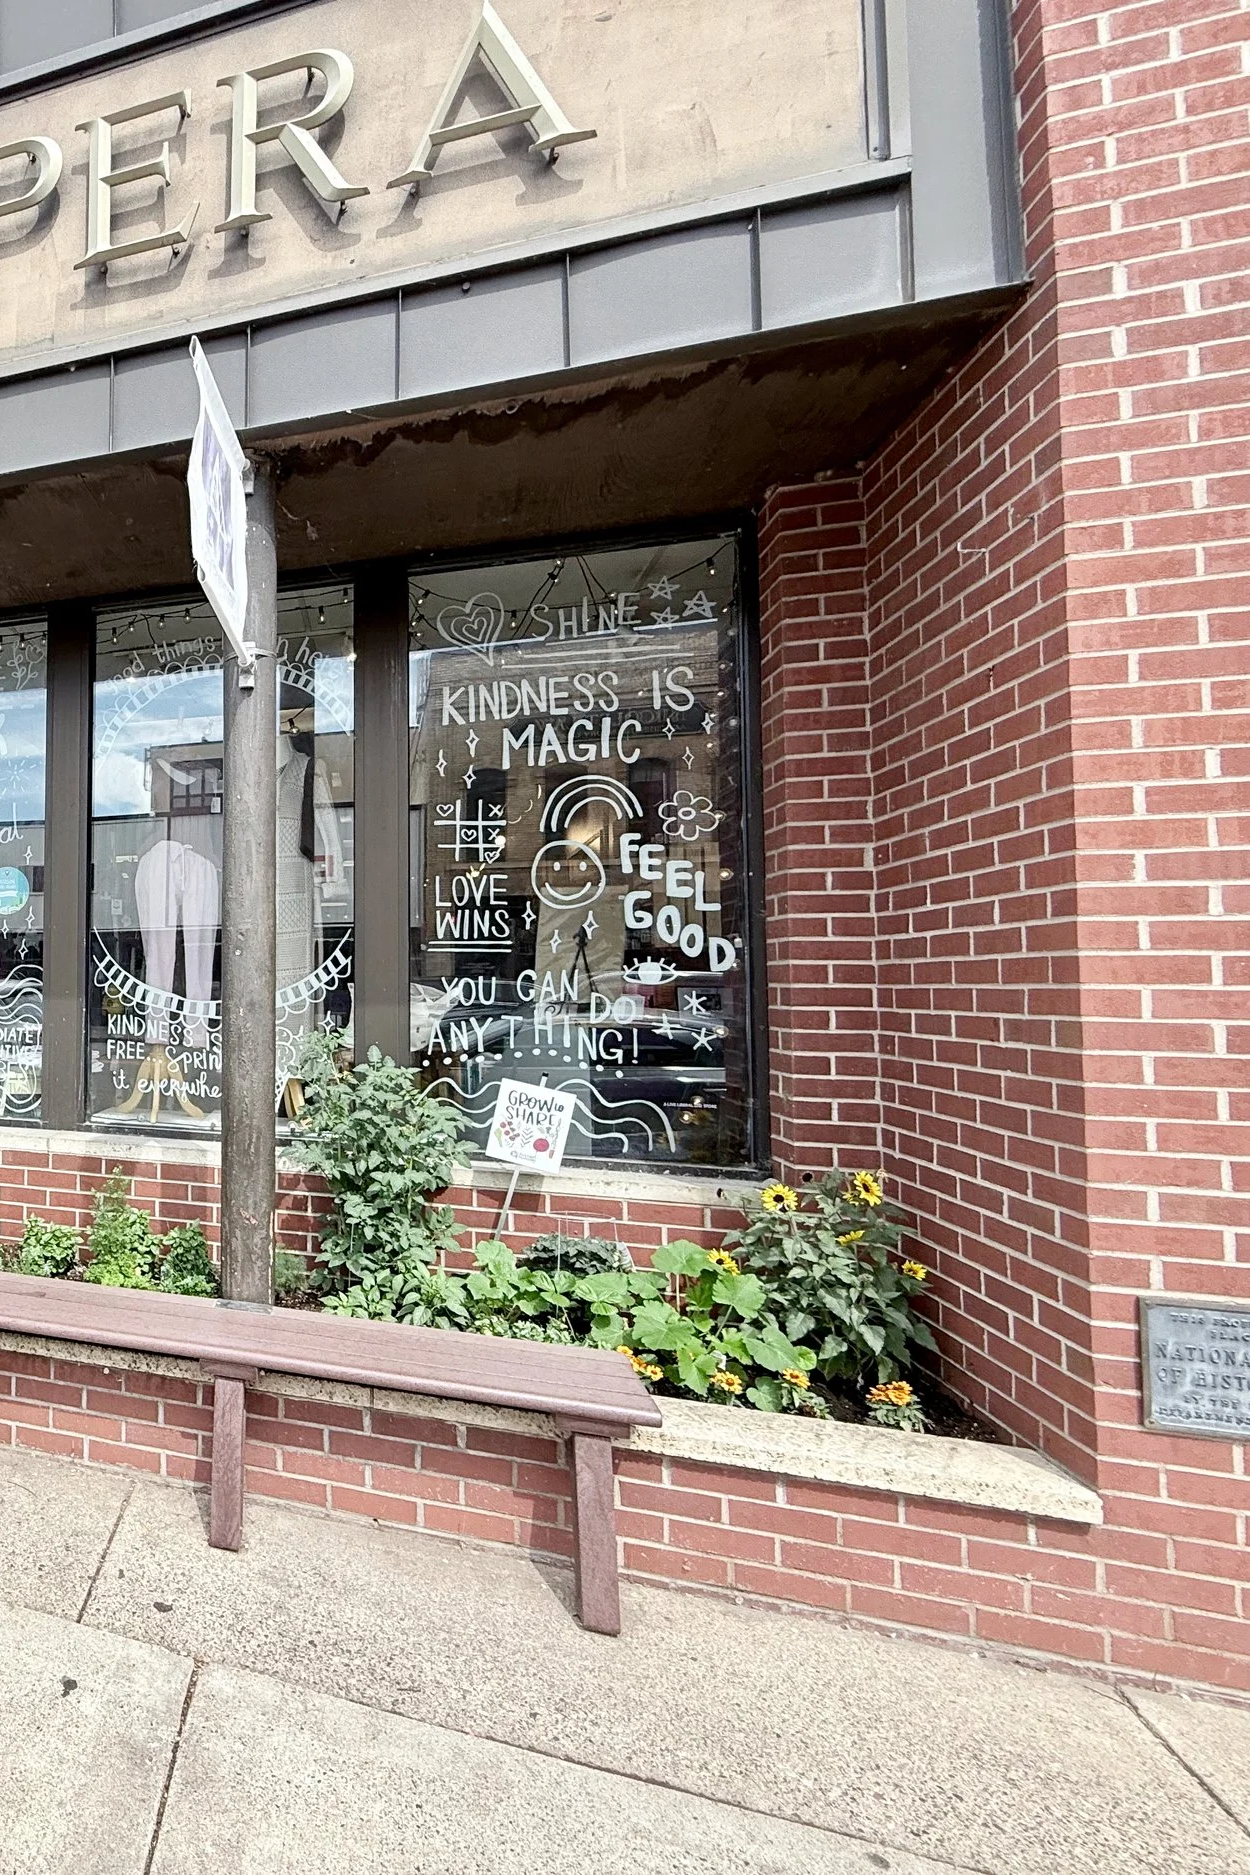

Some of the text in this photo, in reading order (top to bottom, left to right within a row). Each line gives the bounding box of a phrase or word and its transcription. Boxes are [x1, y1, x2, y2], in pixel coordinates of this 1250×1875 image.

[530, 591, 642, 639] SHINE
[150, 634, 216, 666] things
[442, 671, 619, 726] KINDNESS
[652, 666, 695, 711] IS
[502, 716, 641, 770] MAGIC
[620, 832, 721, 912] FEEL
[435, 874, 509, 907] LOVE
[436, 909, 510, 940] WINS
[624, 890, 736, 972] GOOD
[441, 969, 579, 1007] YOU CAN
[590, 992, 637, 1025] DO
[107, 1013, 193, 1048] KINDNESS
[112, 1068, 130, 1090] it
[505, 1105, 556, 1127] SHARE
[508, 1090, 554, 1113] GROW
[1157, 1367, 1250, 1392] OF HIST
